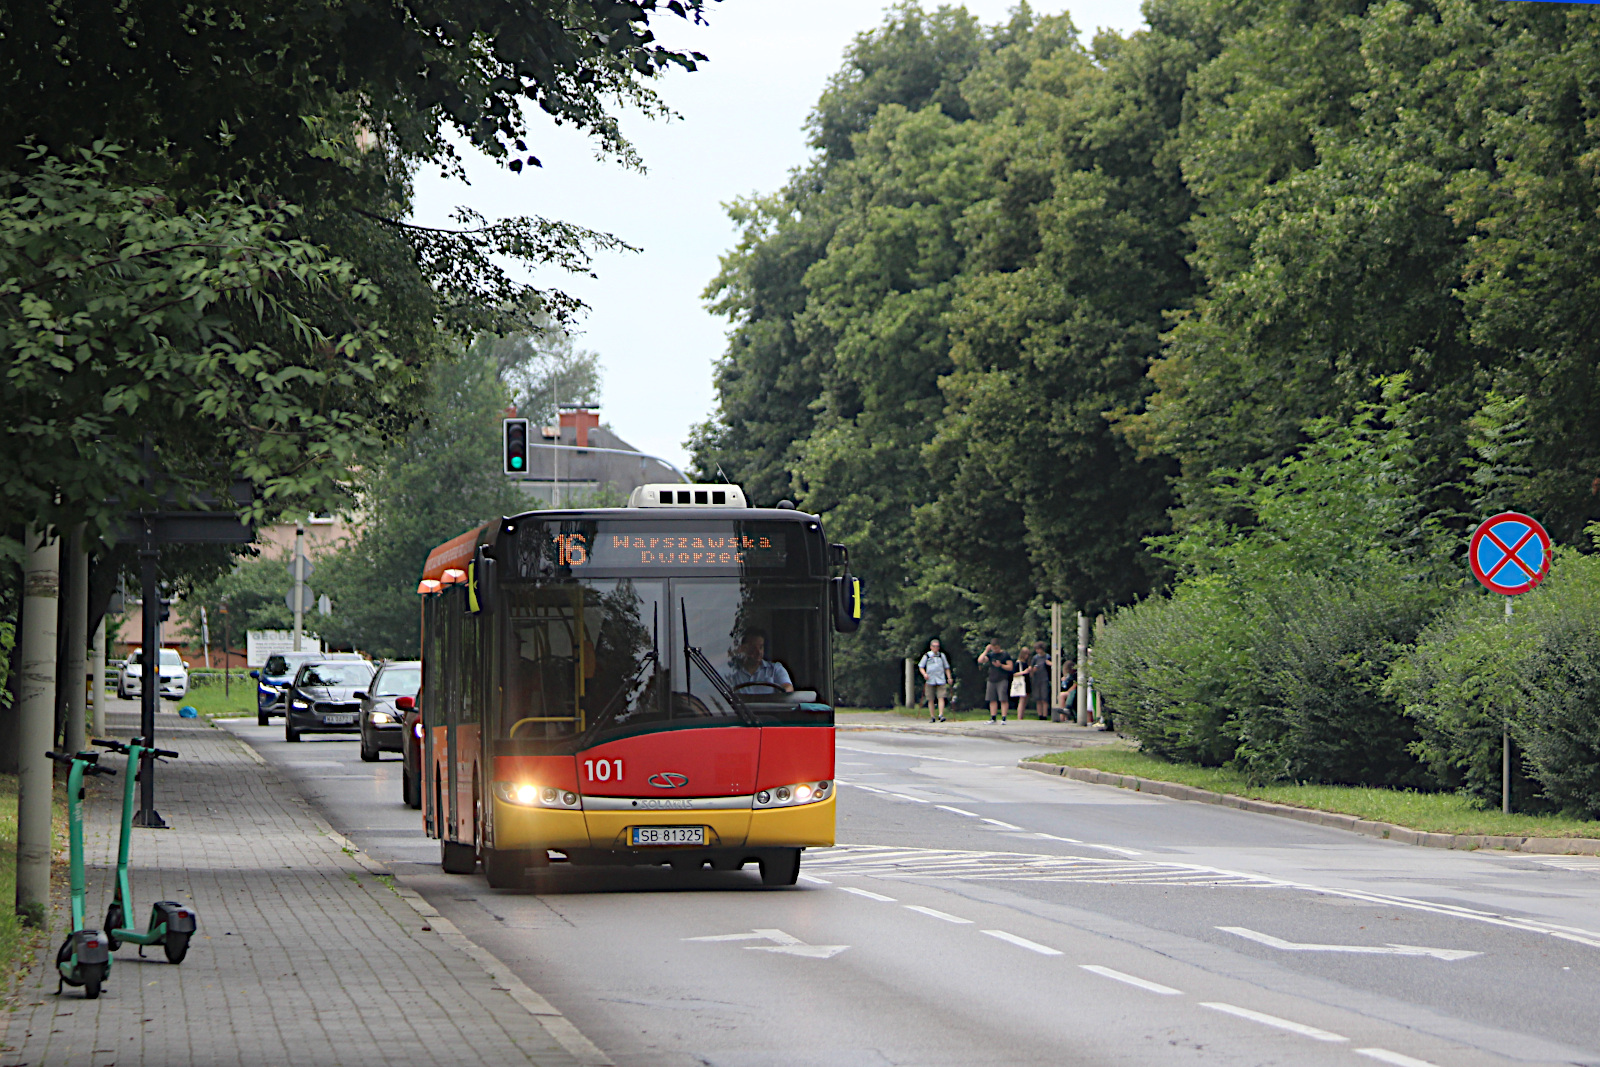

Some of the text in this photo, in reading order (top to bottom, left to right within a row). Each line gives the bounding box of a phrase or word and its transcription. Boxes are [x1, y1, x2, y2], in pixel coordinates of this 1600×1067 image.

[613, 535, 772, 548] Warszawska
[553, 533, 586, 565] 16
[641, 550, 744, 563] Dworzec
[584, 759, 623, 781] 101
[641, 800, 693, 809] SOLARIS
[641, 830, 659, 842] SB
[663, 829, 702, 842] 81325
